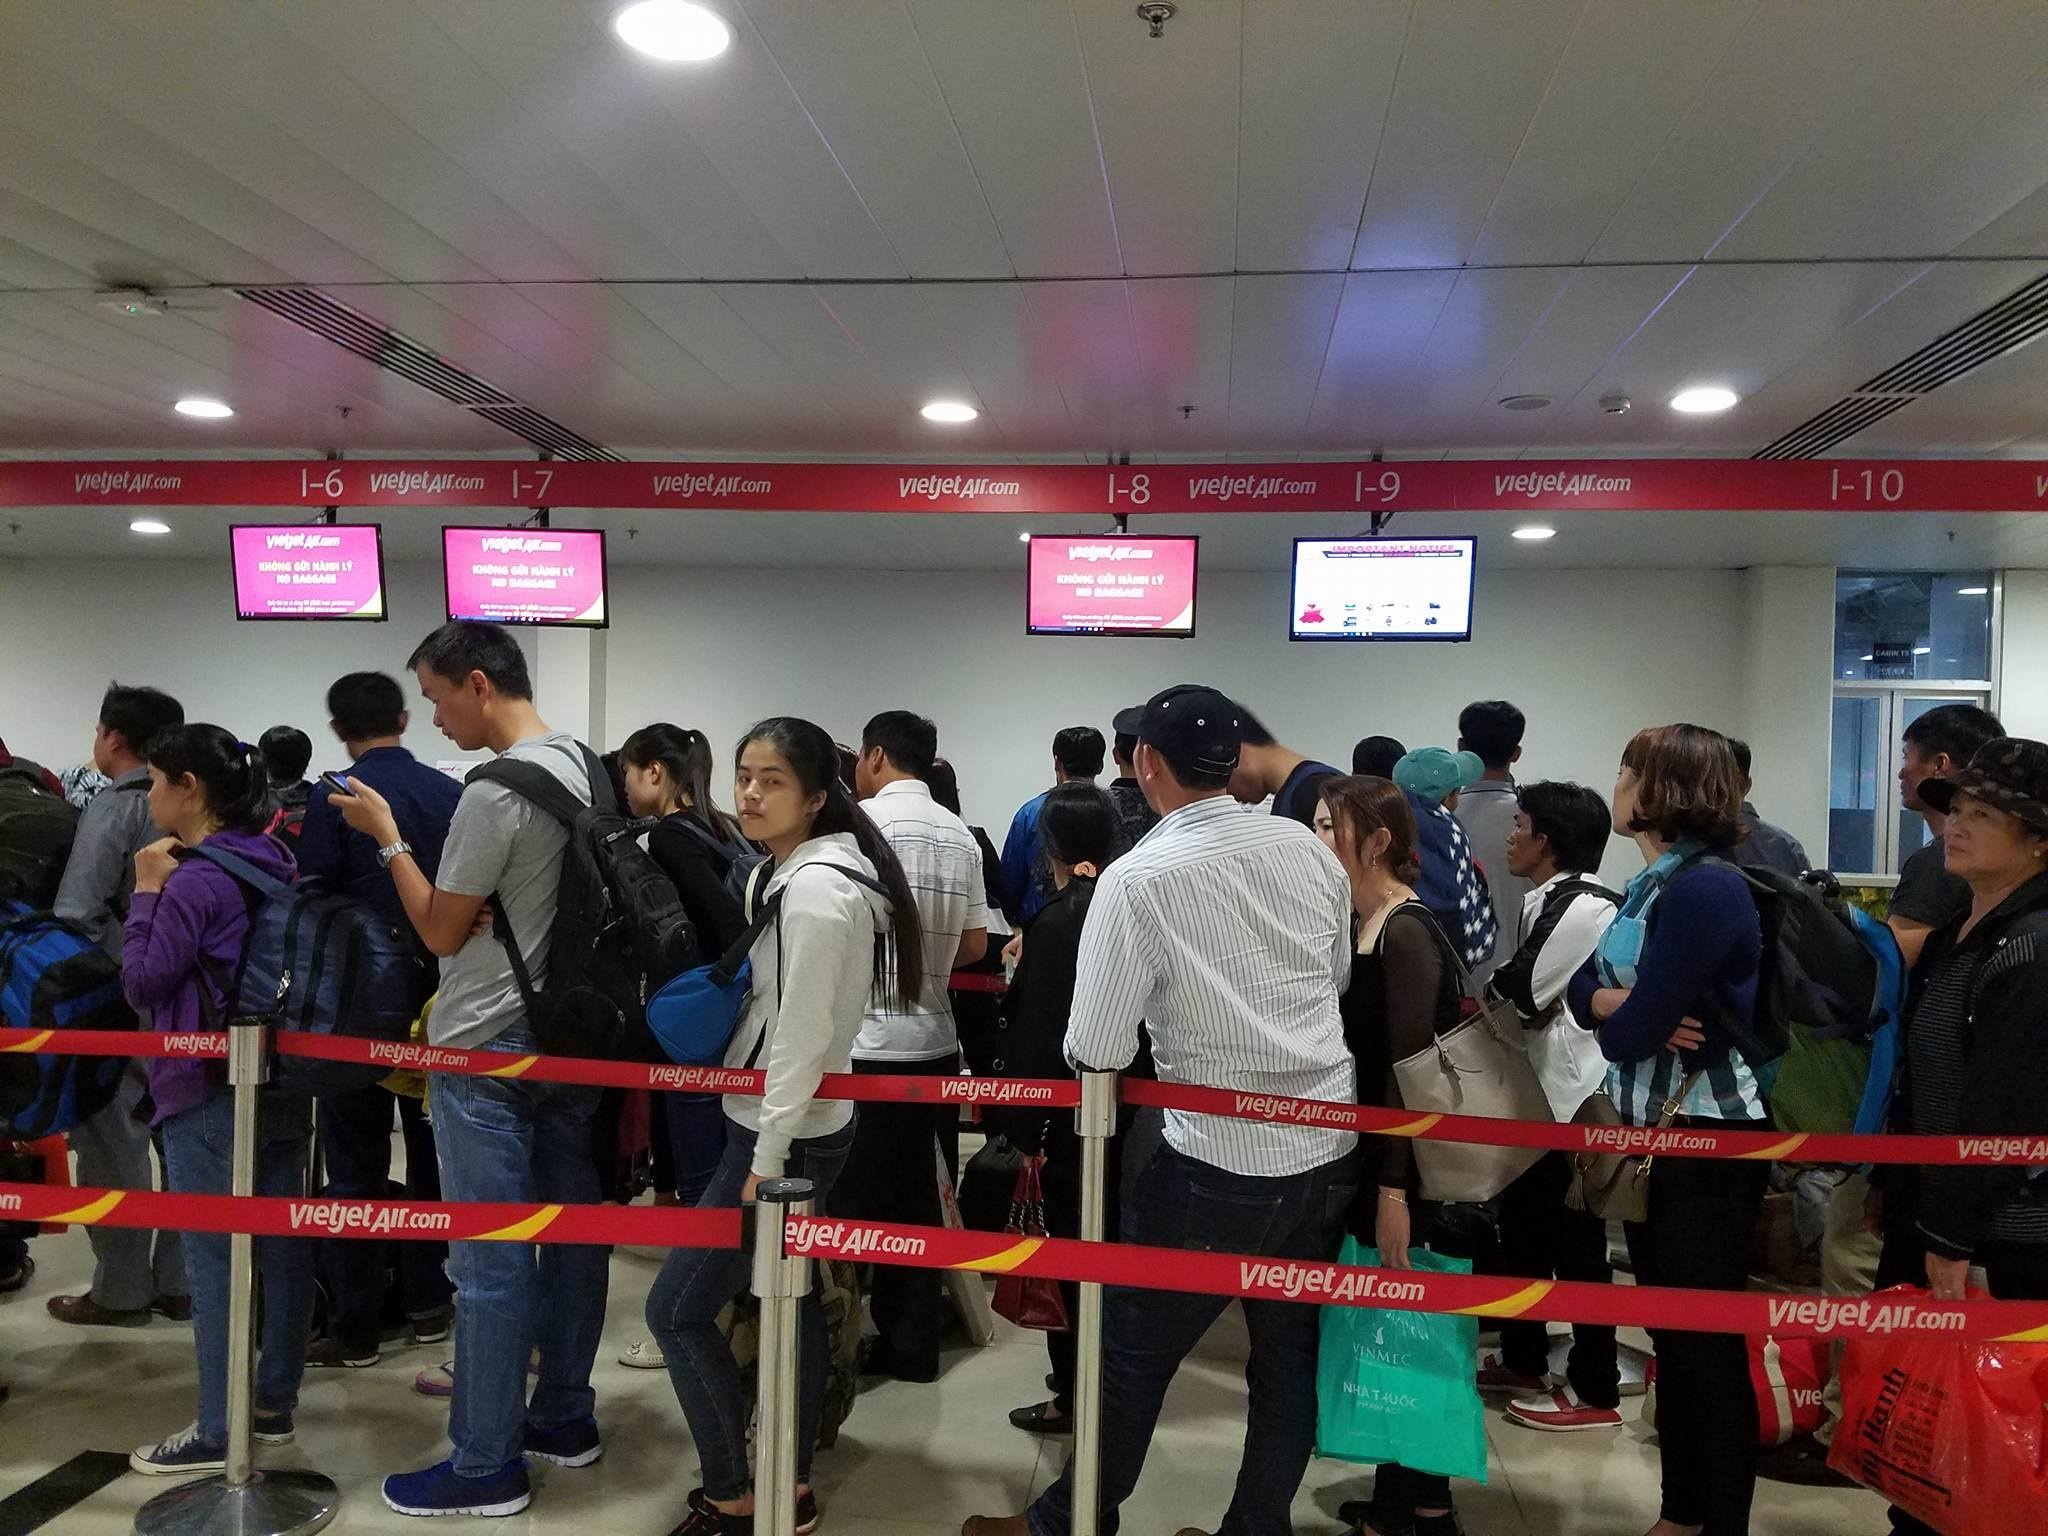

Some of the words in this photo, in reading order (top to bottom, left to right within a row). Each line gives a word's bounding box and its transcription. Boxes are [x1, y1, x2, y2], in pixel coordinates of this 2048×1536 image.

[302, 468, 344, 498] I-6
[512, 469, 553, 499] I-7
[1107, 473, 1152, 504] I-8
[1355, 471, 1401, 502] I-9
[1831, 468, 1905, 502] I-10
[1409, 544, 1455, 552] NOTICE
[164, 1034, 228, 1055] VietjetA
[1958, 1138, 2048, 1161] VietjetA
[289, 1202, 451, 1234] VietjetAir.com
[784, 1219, 927, 1256] etjetAir.com
[1240, 1261, 1426, 1302] VietjetAir.com
[1767, 1298, 1967, 1334] VietjetAir.com
[1352, 1342, 1412, 1368] VINMEC
